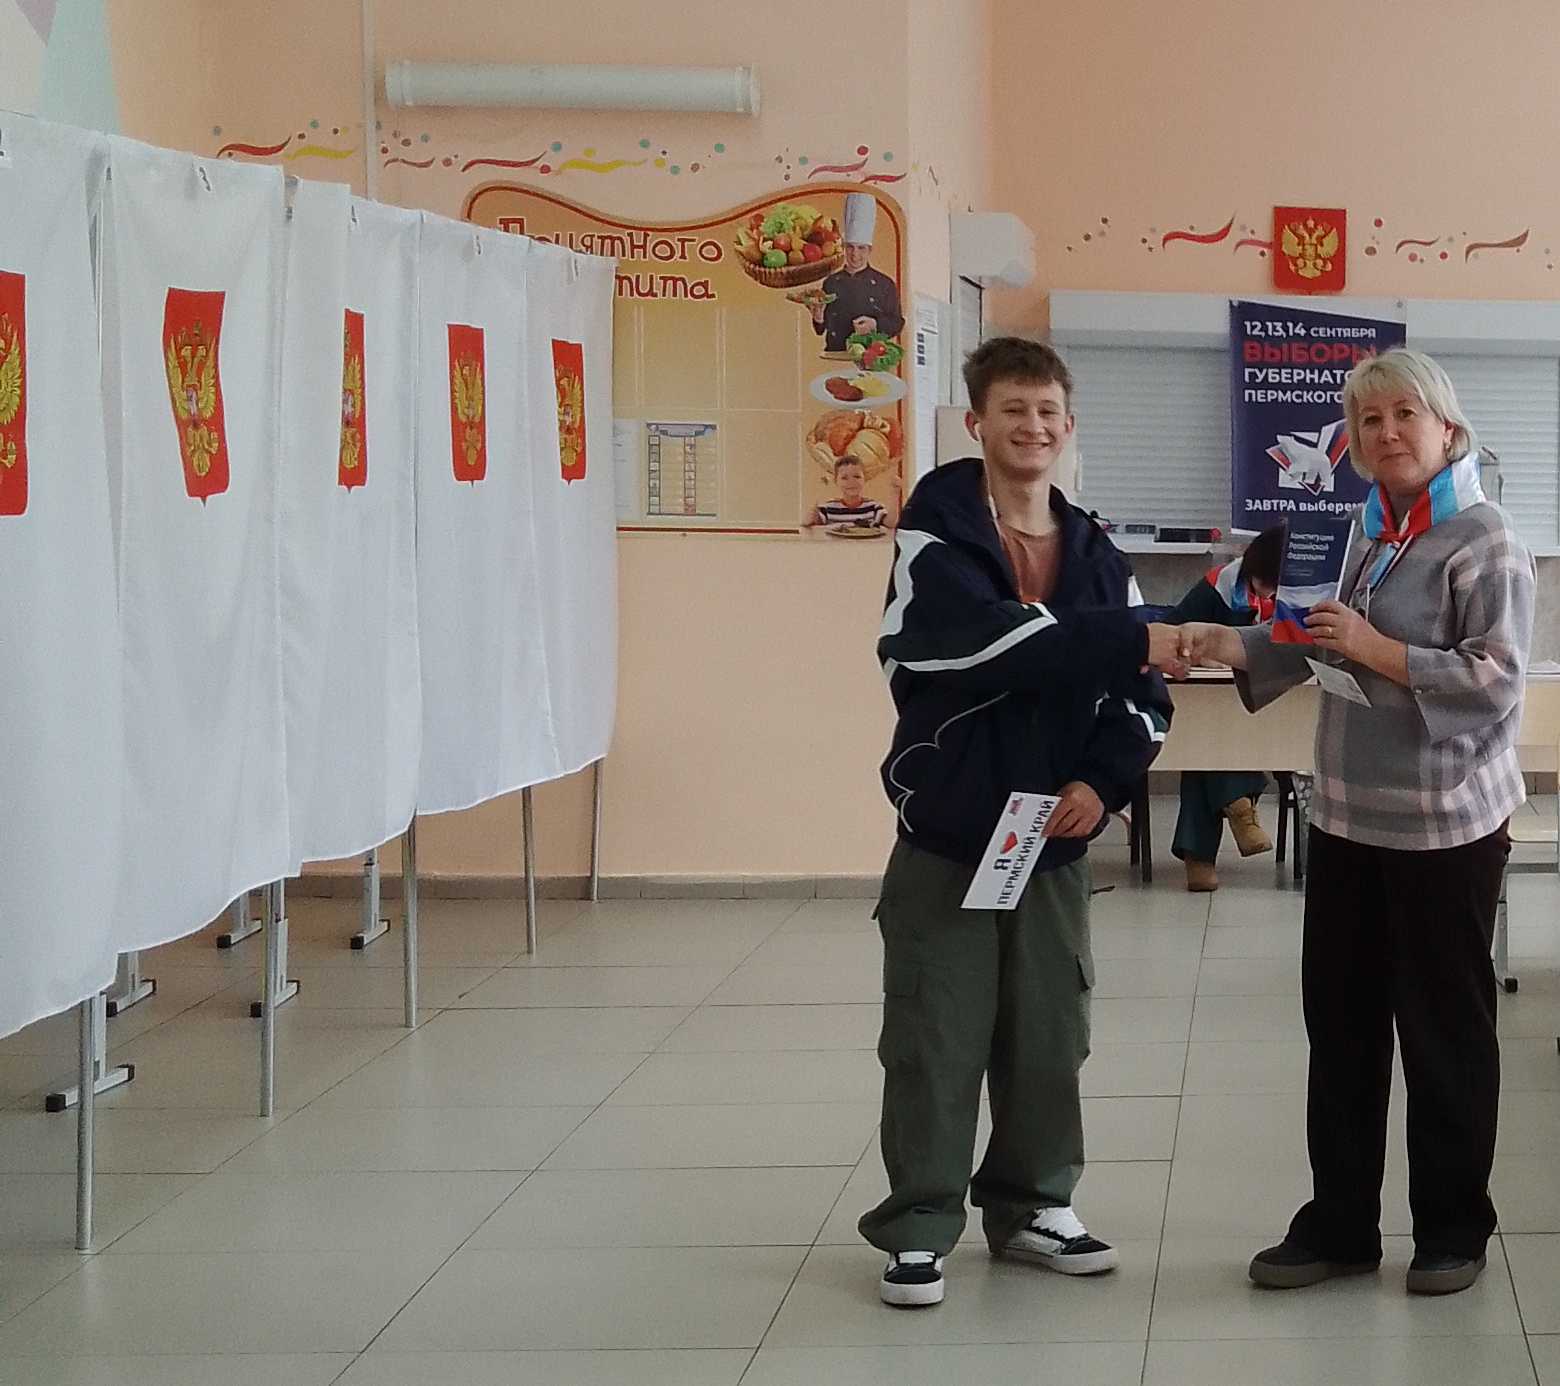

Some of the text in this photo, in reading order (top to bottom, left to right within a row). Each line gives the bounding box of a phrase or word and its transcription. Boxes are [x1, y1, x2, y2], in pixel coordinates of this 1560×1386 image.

[1244, 320, 1377, 339] 12,13,14 СЕНТЯБРЯ
[1245, 498, 1297, 512] ЗАВТРА
[993, 858, 1012, 871] Я
[996, 835, 1038, 905] ПЕРМСКИЙ
